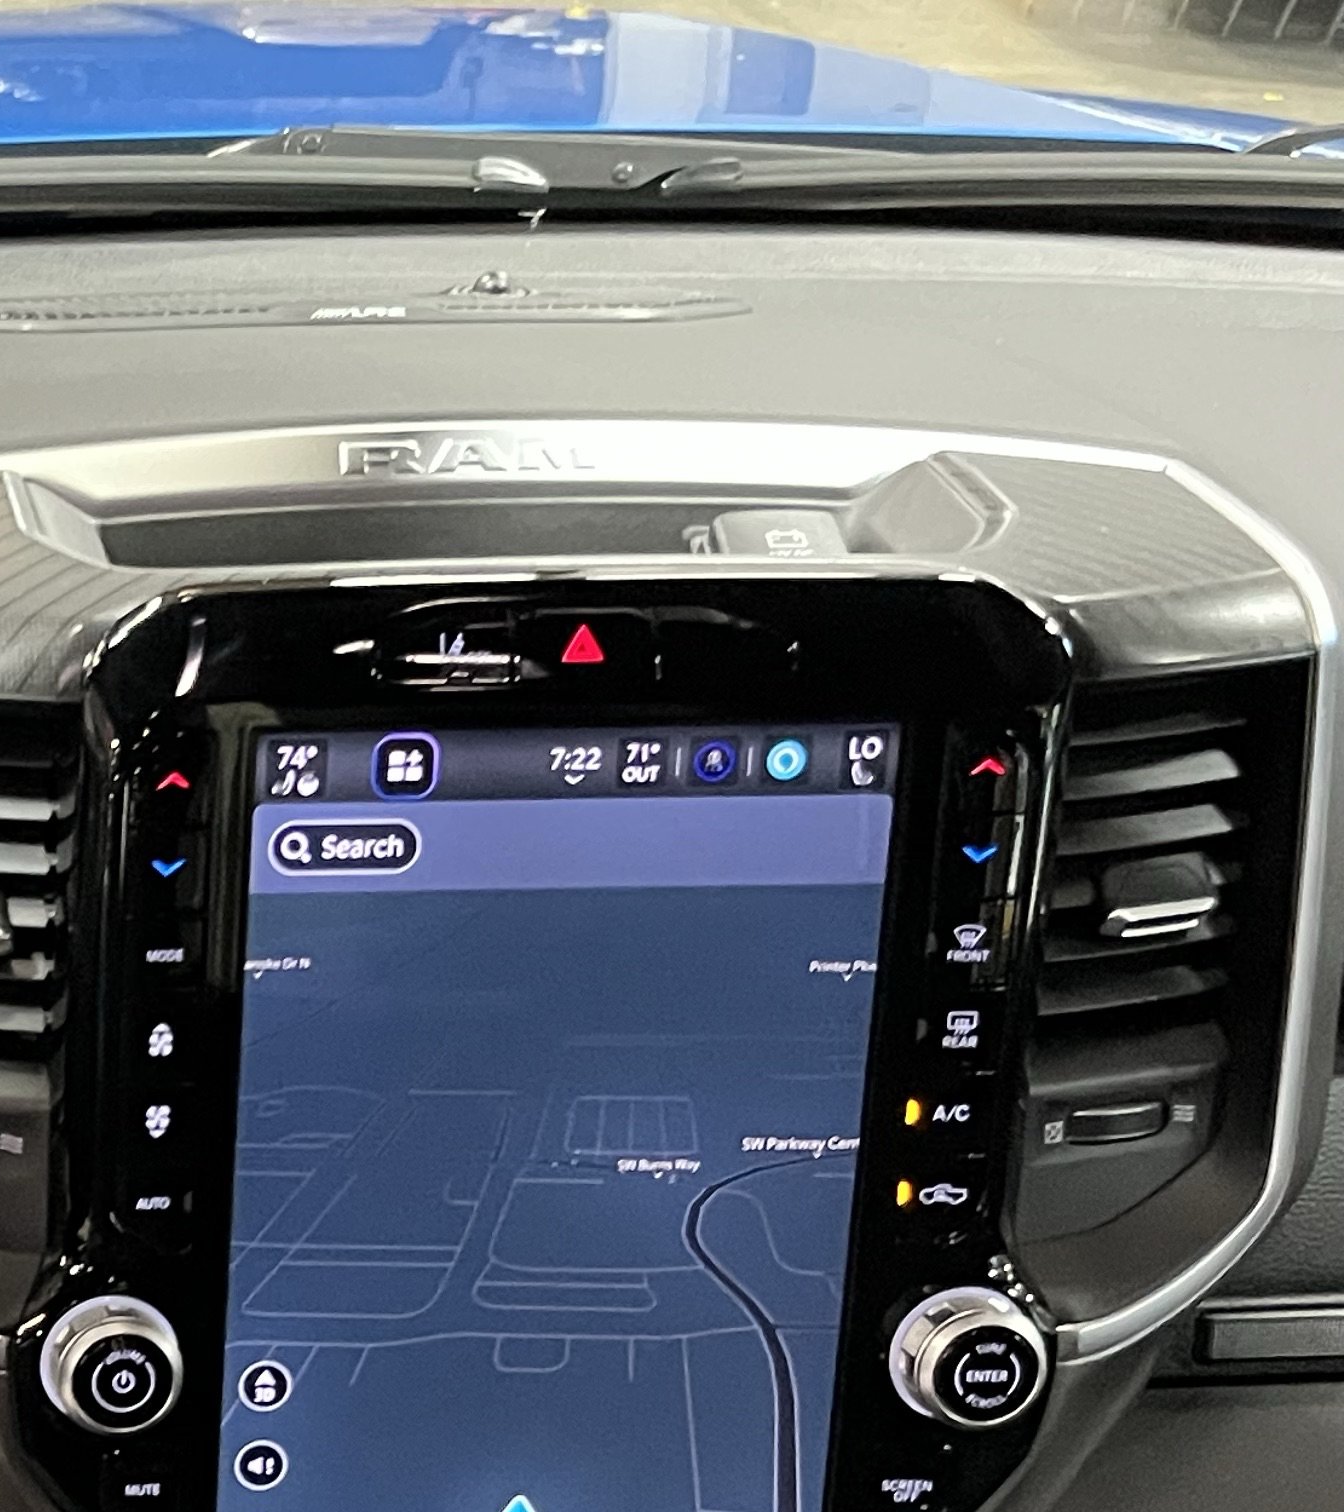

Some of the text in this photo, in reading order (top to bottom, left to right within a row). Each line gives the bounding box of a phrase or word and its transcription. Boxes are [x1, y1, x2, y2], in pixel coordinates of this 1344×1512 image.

[338, 437, 596, 476] RAM
[848, 735, 884, 760] LO
[549, 747, 603, 771] 7:22
[622, 764, 661, 784] OUT
[321, 833, 405, 860] Search
[946, 949, 990, 962] FRONT
[932, 1104, 971, 1123] A/C
[741, 1137, 765, 1152] SW
[766, 1136, 826, 1155] Parkway
[135, 1197, 171, 1210] AUTO
[966, 1370, 1008, 1383] ENTER
[124, 1483, 161, 1496] MUTE
[881, 1479, 934, 1492] SCREEN
